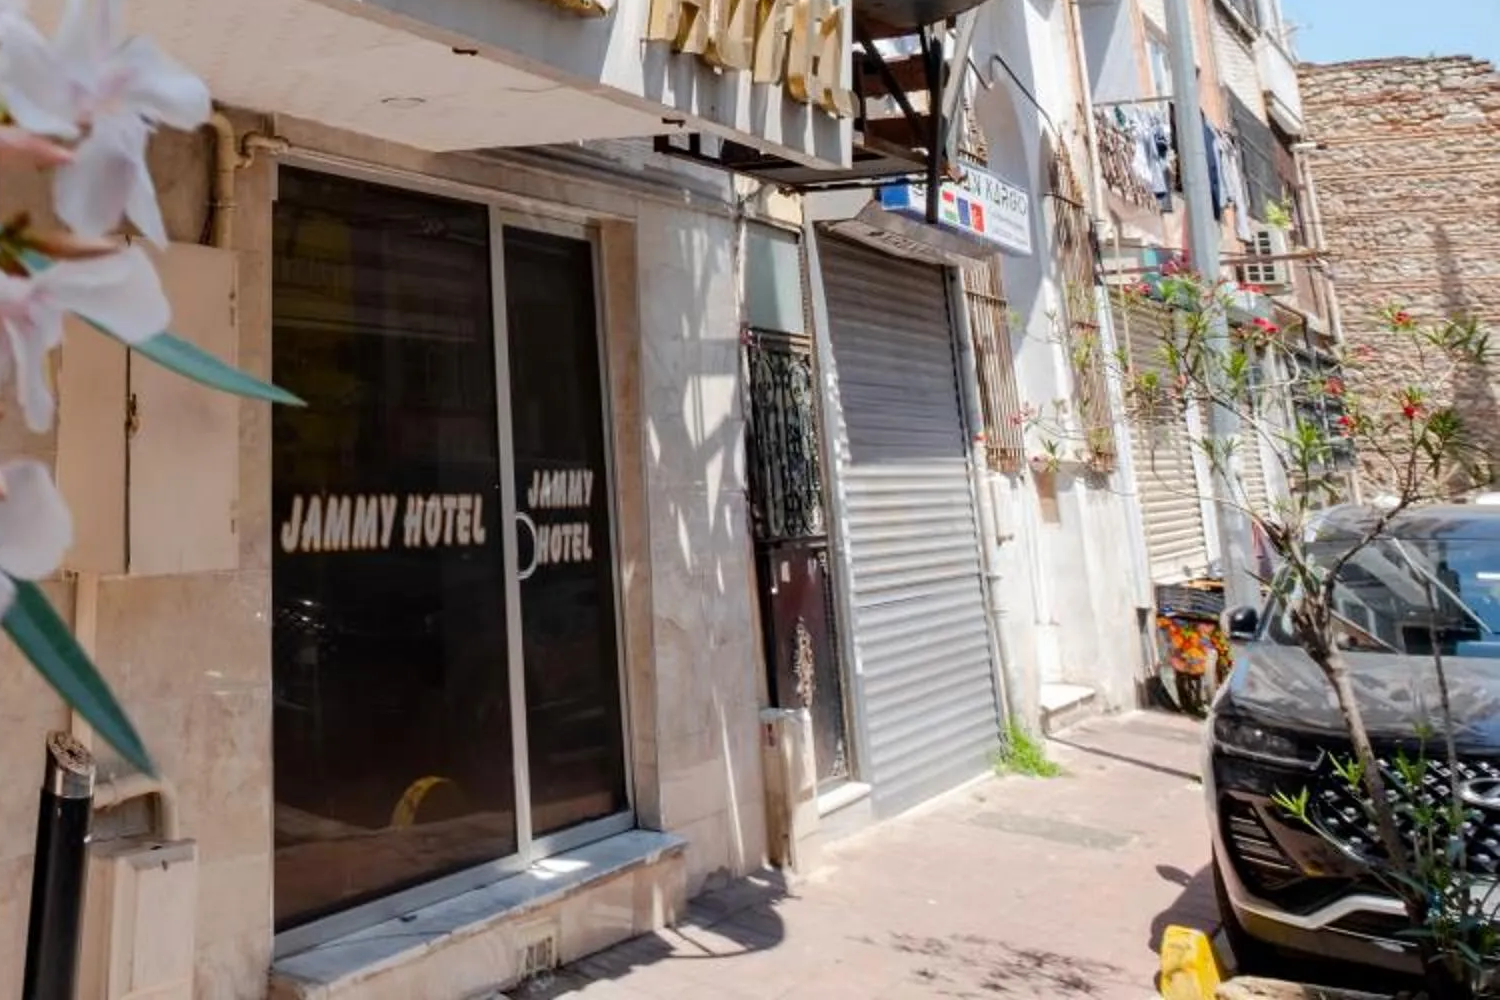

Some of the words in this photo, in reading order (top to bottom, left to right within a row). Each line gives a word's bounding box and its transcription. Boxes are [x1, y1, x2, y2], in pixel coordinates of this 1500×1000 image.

[527, 470, 593, 509] JAMMY
[281, 495, 397, 552] JAMMY
[404, 494, 486, 547] HOTEL
[536, 522, 592, 563] HOTEL
